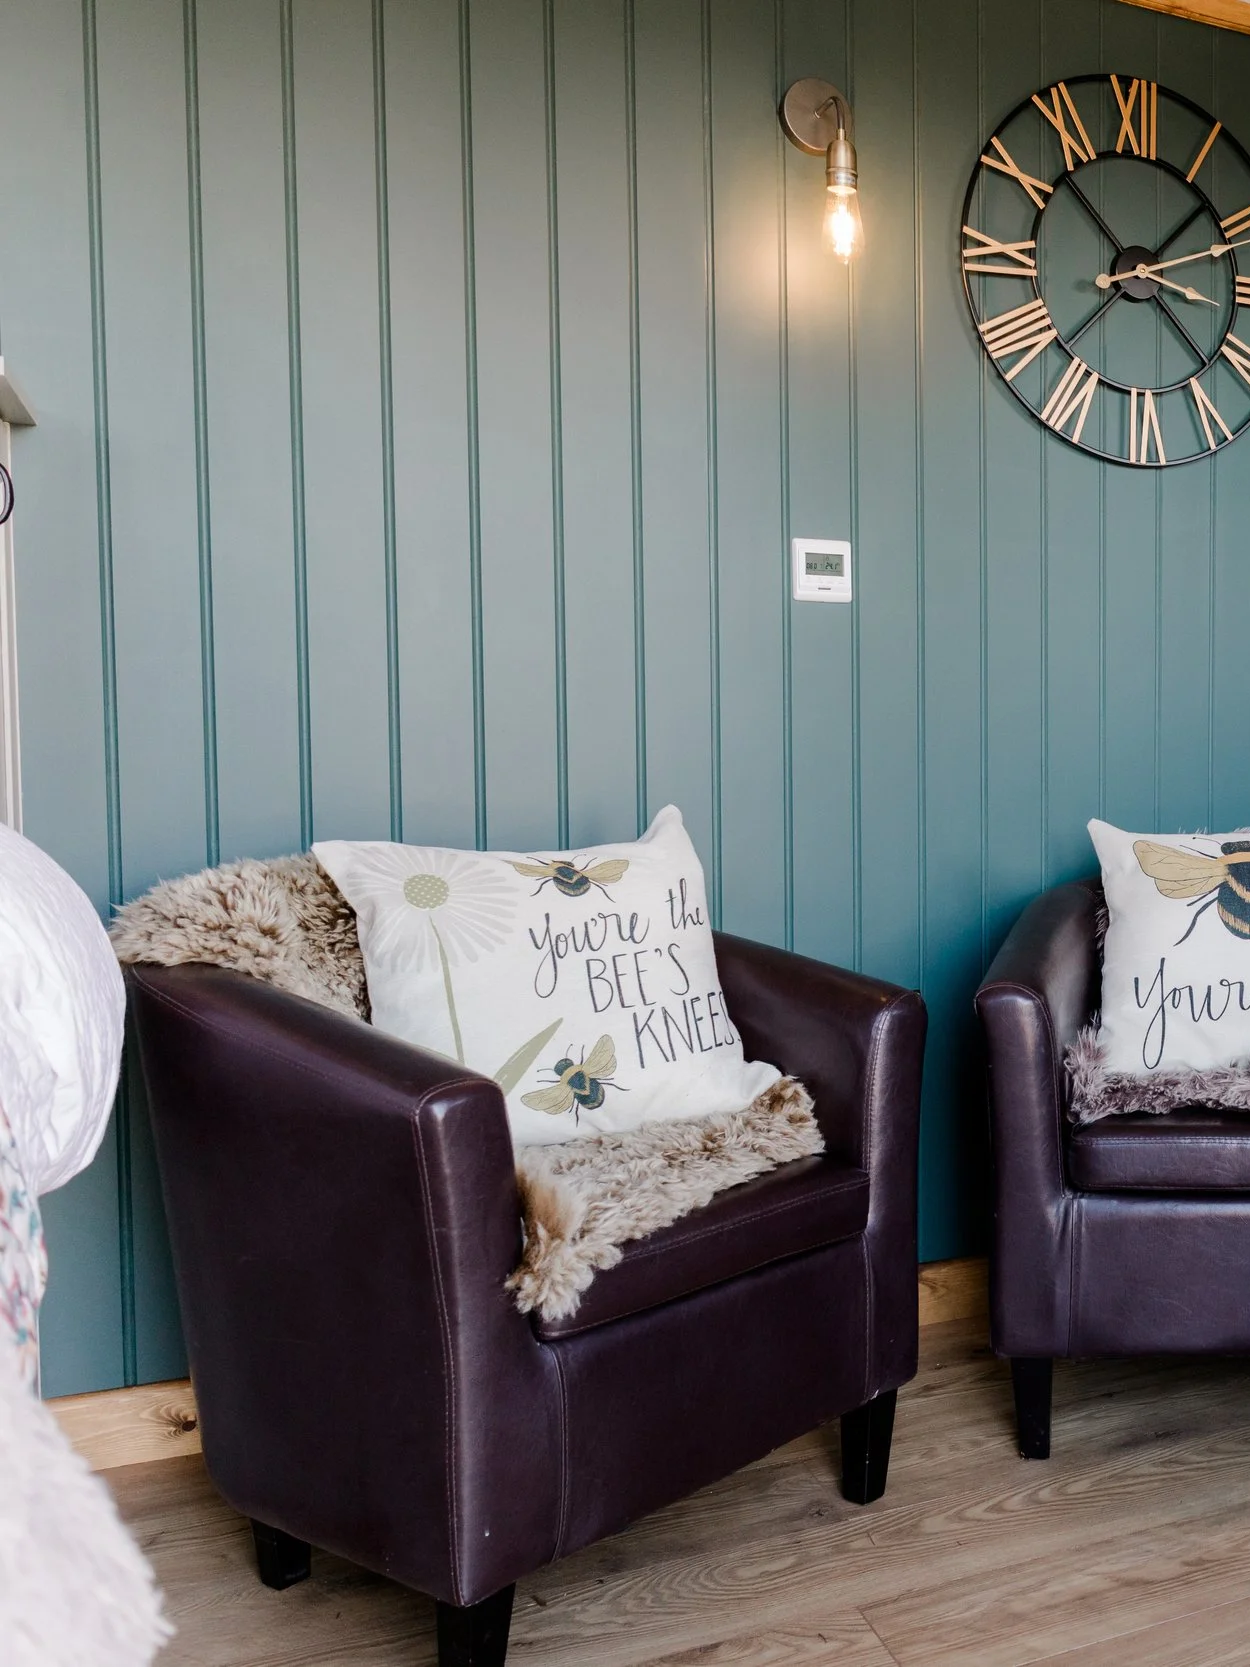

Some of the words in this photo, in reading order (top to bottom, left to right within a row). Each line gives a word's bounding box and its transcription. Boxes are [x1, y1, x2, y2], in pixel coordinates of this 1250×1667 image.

[1031, 82, 1097, 171] XI
[1110, 74, 1158, 160] XII
[980, 136, 1054, 209] X
[962, 225, 1037, 276] IX
[978, 298, 1058, 382] VIII
[1040, 357, 1099, 443] VII
[1129, 387, 1167, 465] VI
[1188, 376, 1234, 450] V
[585, 942, 690, 1013] BEE'S
